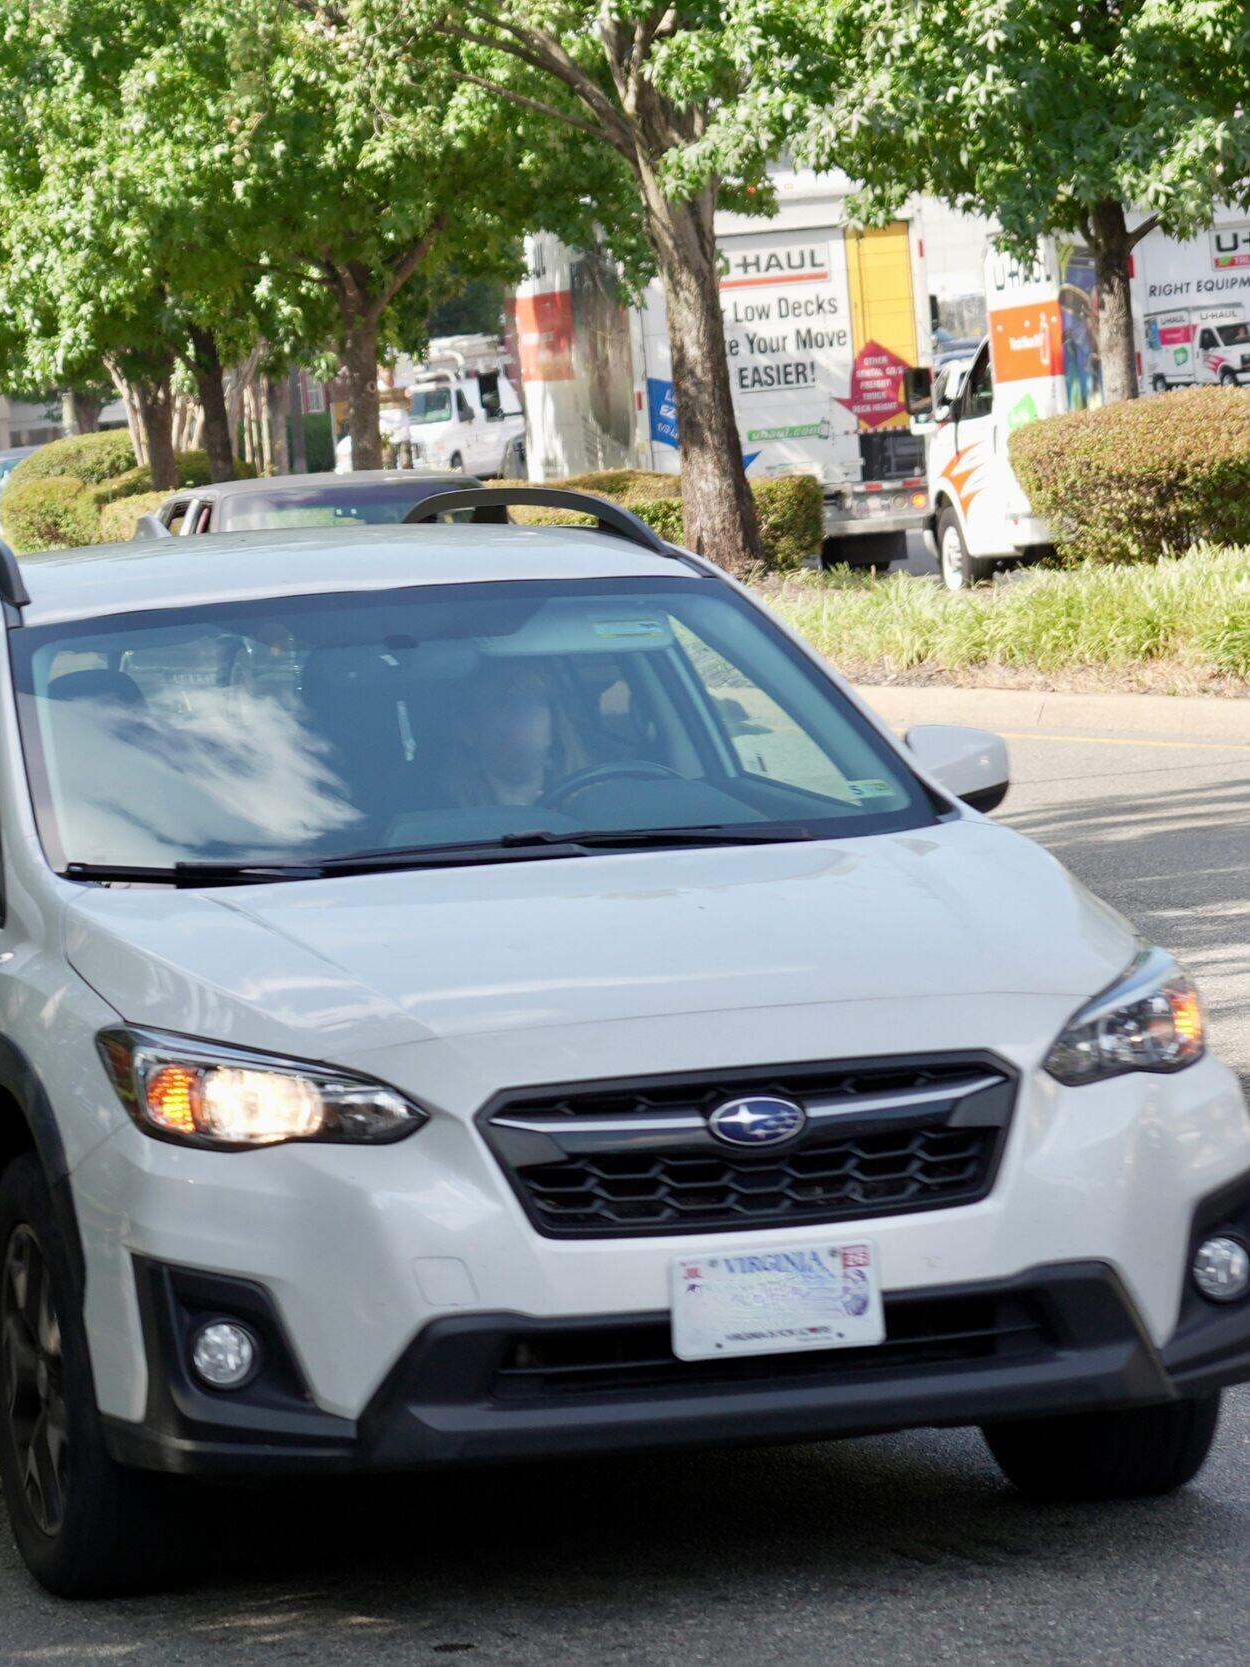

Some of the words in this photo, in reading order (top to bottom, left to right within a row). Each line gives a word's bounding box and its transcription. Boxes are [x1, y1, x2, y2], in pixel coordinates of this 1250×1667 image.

[1148, 281, 1191, 297] RIGHT
[733, 300, 771, 323] Low
[777, 293, 839, 319] Decks
[745, 331, 788, 355] Your
[795, 327, 848, 350] Move
[737, 361, 816, 389] EASIER!
[723, 1250, 837, 1279] VIRGINIA
